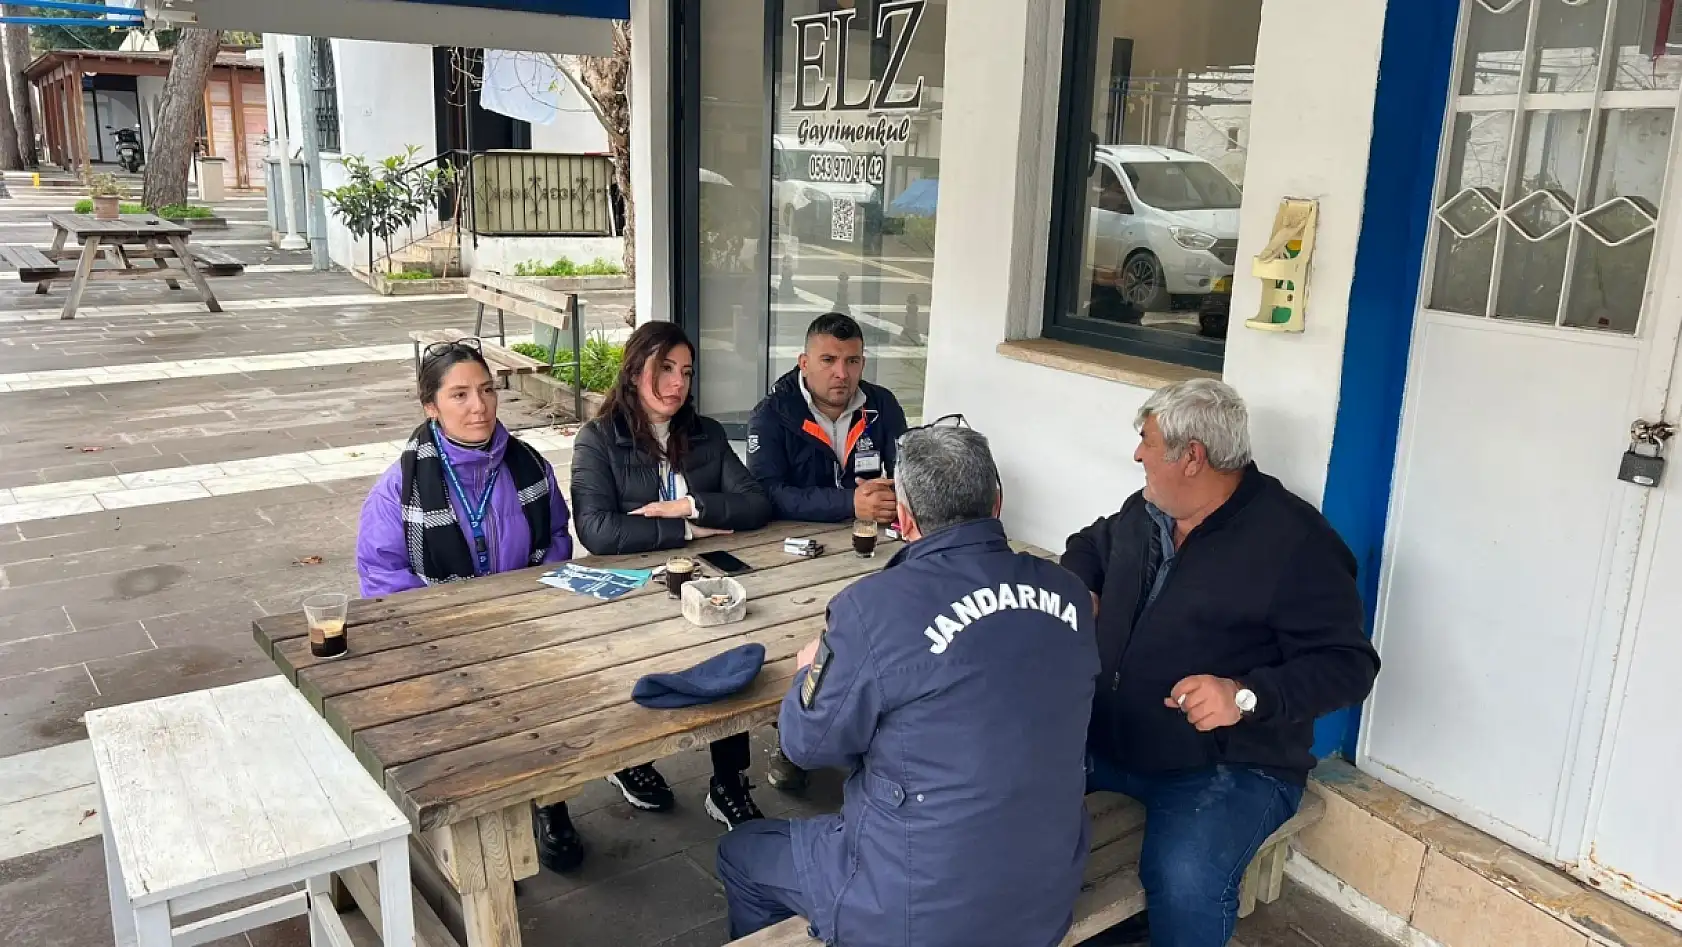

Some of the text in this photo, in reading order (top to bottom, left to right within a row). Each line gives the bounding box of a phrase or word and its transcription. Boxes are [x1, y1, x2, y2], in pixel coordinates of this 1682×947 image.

[791, 0, 927, 111] ELZ
[798, 116, 910, 147] Gayrimenkul
[810, 155, 883, 183] 0543 970 41 42
[924, 583, 1078, 654] JANDARMA
